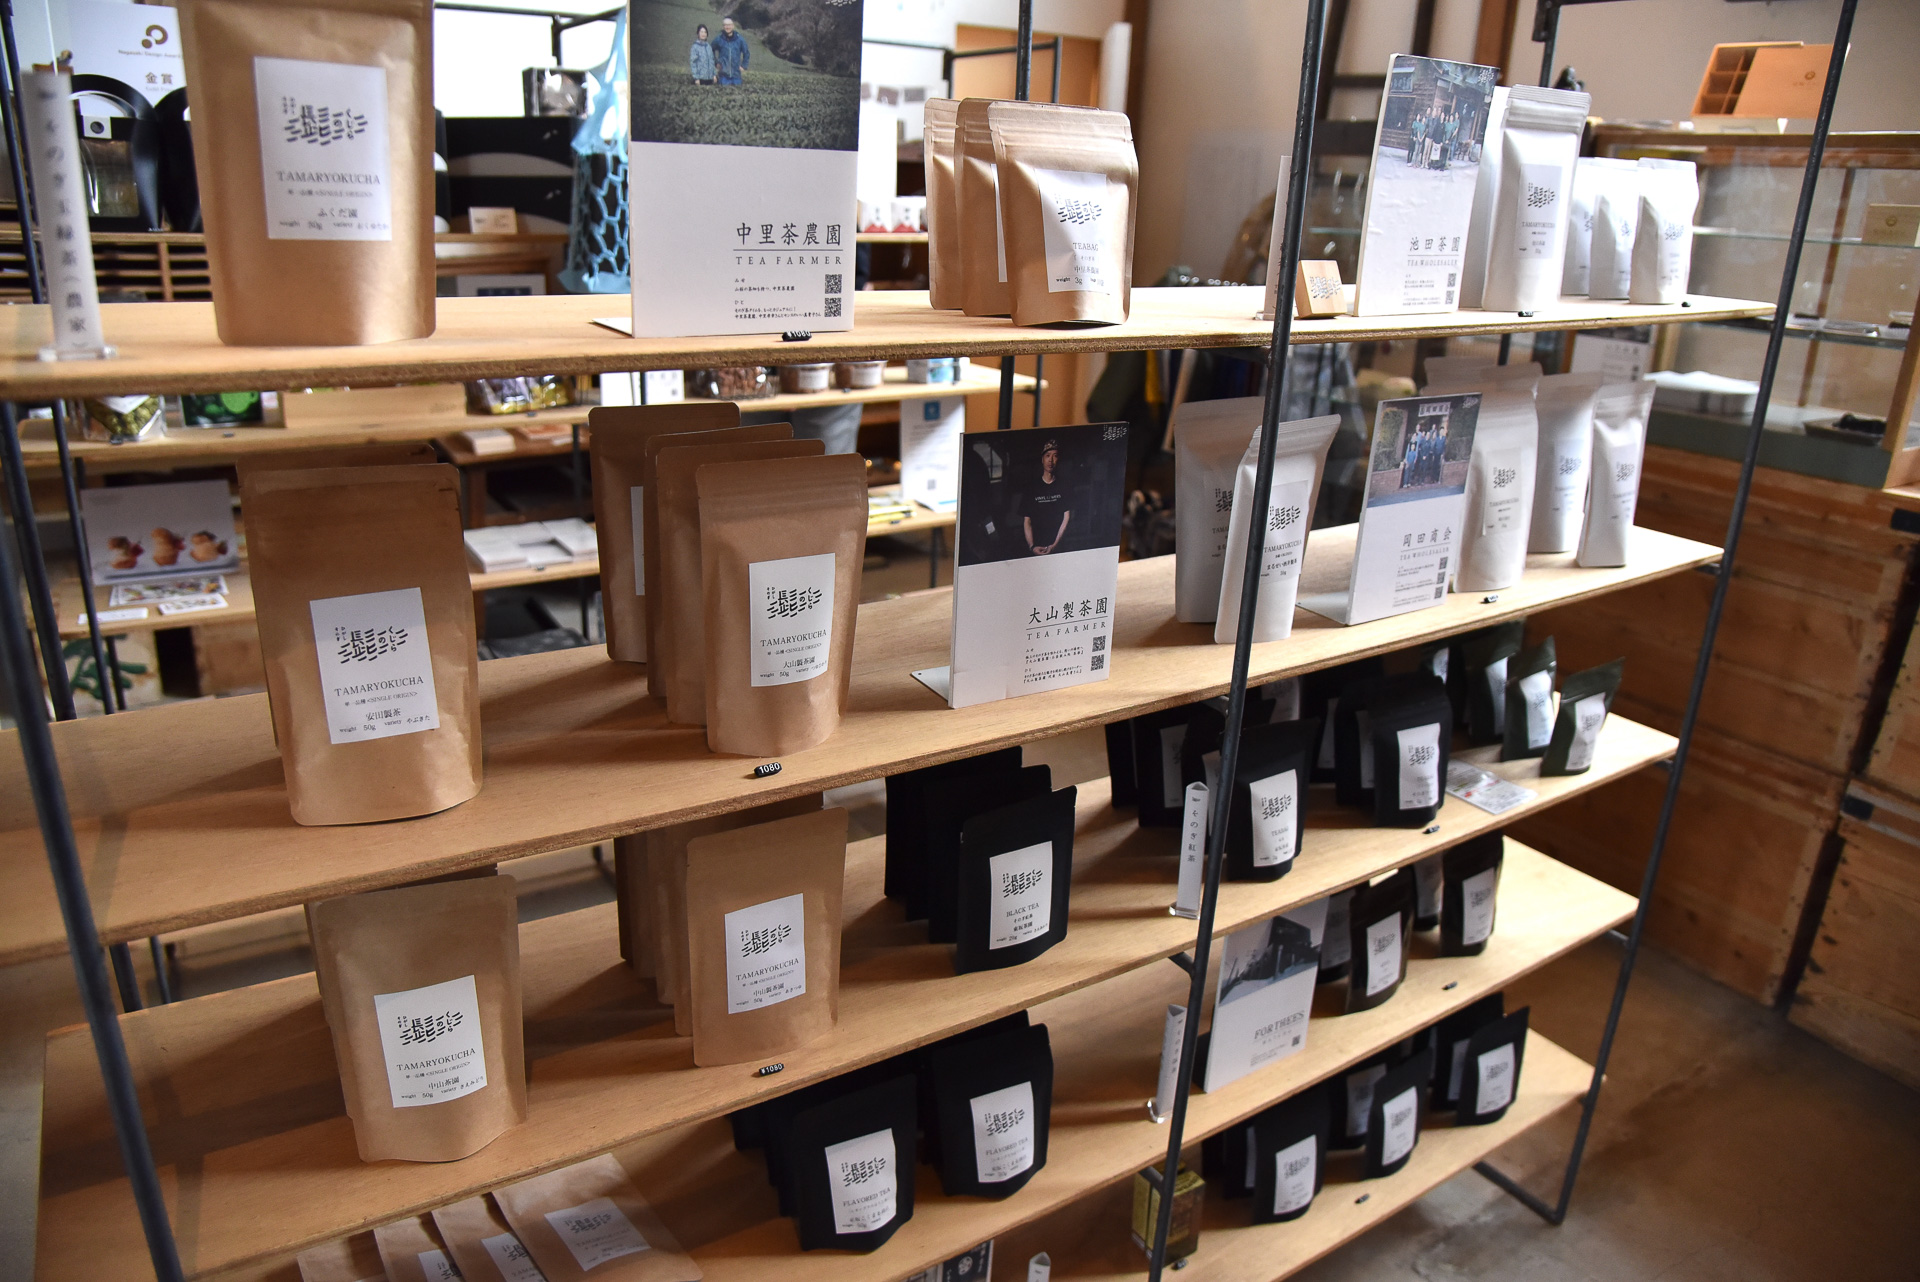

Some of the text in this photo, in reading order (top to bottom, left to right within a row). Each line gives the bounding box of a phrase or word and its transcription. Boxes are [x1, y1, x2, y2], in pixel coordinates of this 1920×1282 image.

[145, 72, 173, 85] 金賞
[276, 171, 381, 185] TAMARYOKUCHA
[317, 207, 359, 219] ふくだ園
[736, 222, 842, 246] 中里茶農園
[1409, 236, 1461, 252] 池田茶園
[735, 256, 842, 265] TEA FARMER
[1407, 259, 1418, 267] TEA
[1028, 597, 1108, 624] 大山製茶園
[760, 629, 827, 647] TAMARYOKUCHA
[1027, 622, 1106, 640] TEA FARMER
[783, 656, 816, 669] 大山製茶園
[334, 676, 424, 697] TAMARYOKUCHA
[365, 708, 402, 721] 安田製茶
[339, 725, 357, 733] weight
[363, 724, 377, 732] 50g
[406, 714, 431, 724] やぶきた
[759, 762, 780, 774] 1080
[1187, 809, 1199, 863] そのぎ紅茶
[1006, 902, 1040, 918] BLACK TEA
[735, 958, 800, 981] TAMARYOKUCHA
[753, 982, 785, 996] 中山製茶園
[396, 1047, 476, 1071] TAMARYOKUCHA
[761, 1063, 783, 1074] ¥1080
[428, 1076, 460, 1090] 中山茶園
[842, 1193, 879, 1207] FLAVORED
[878, 1187, 891, 1196] TEA
